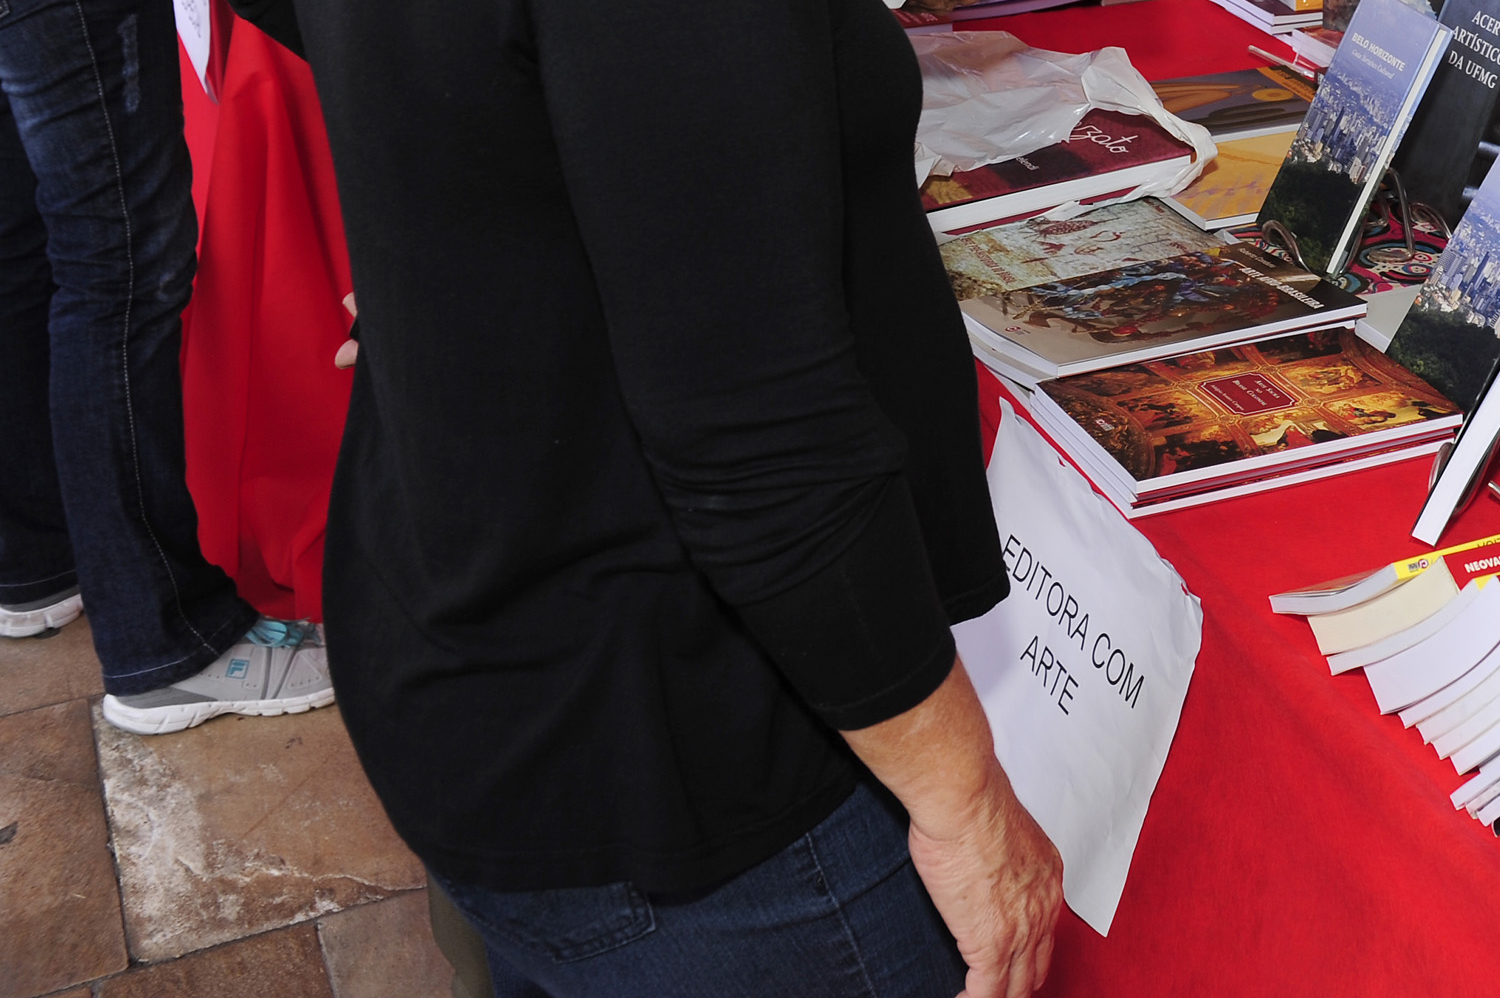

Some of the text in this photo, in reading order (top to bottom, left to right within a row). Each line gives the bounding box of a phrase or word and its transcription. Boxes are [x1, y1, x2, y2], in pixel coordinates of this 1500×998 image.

[1352, 33, 1406, 72] BELO HORIZONTE
[1448, 50, 1498, 89] DA UFMG
[1002, 535, 1145, 709] EDITORA COM
[1019, 634, 1080, 716] ARTE
